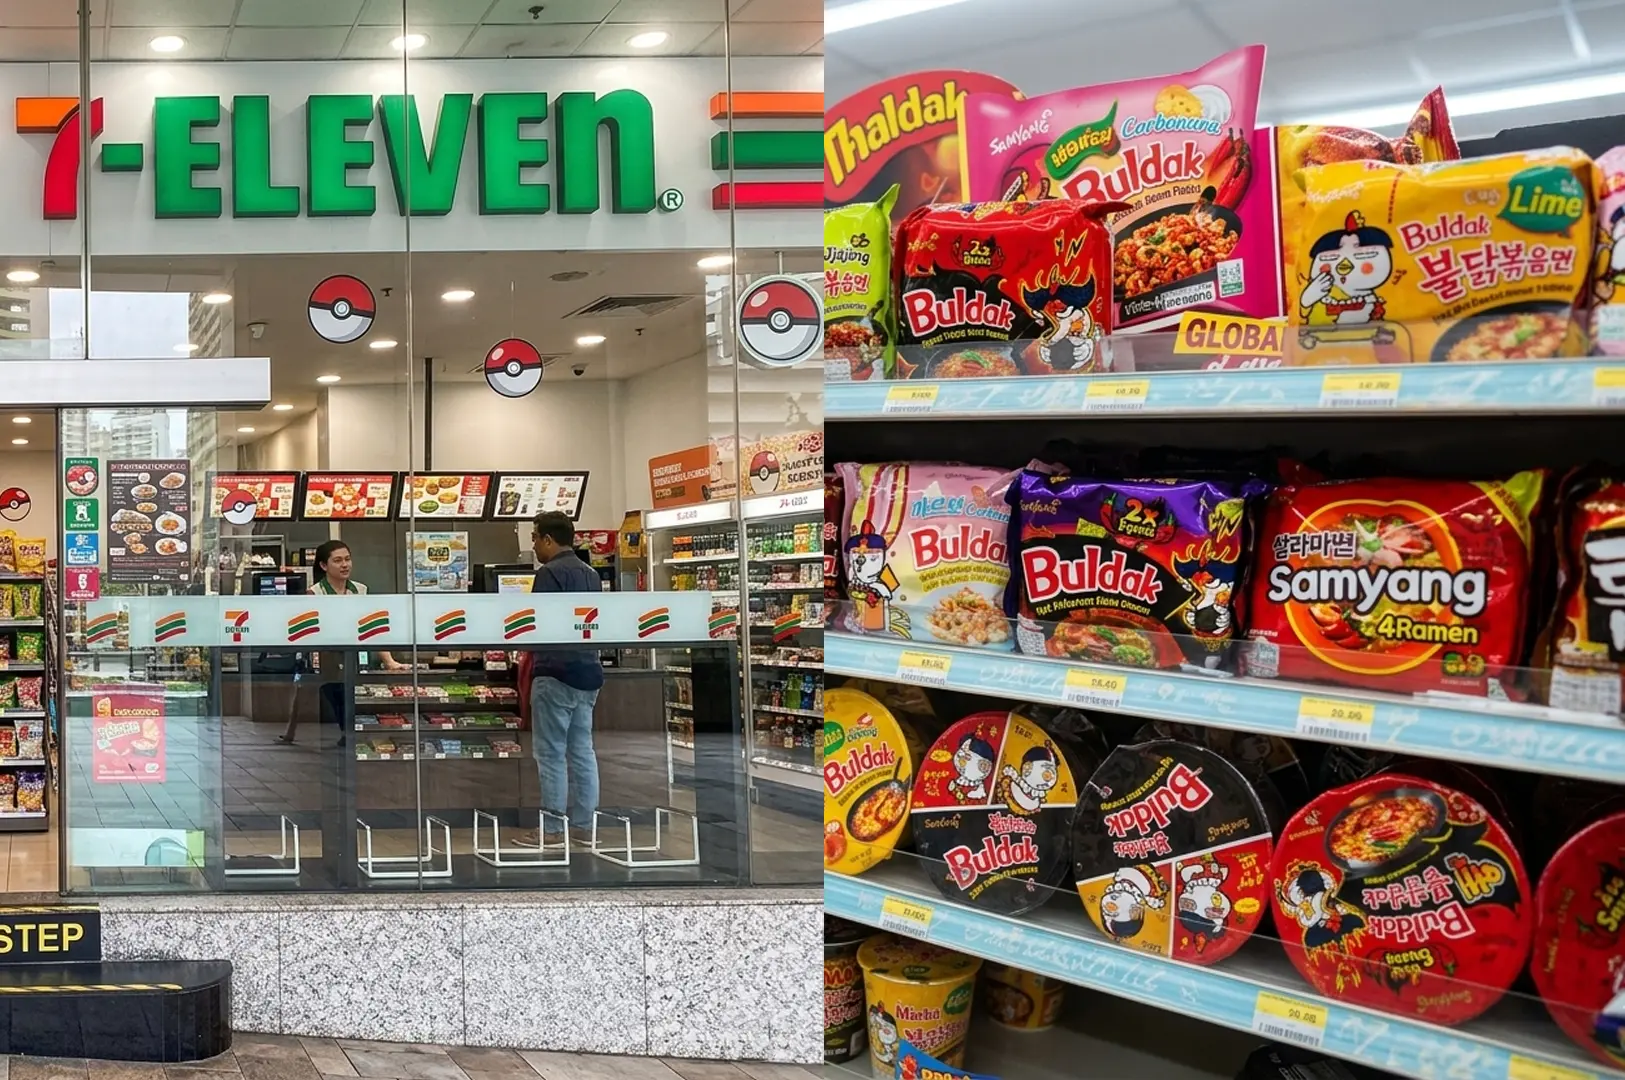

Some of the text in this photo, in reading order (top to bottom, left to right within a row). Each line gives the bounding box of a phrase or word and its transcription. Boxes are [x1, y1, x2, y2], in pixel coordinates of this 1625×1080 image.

[1510, 185, 1582, 217] Lime
[1399, 214, 1490, 252] Buldak
[903, 287, 1015, 336] Buldak
[1185, 317, 1284, 352] GLOBA
[1126, 499, 1159, 527] 2x
[909, 525, 1009, 570] Bulda
[1021, 545, 1163, 603] Buldak
[1267, 564, 1488, 617] Samyang
[1105, 763, 1213, 838] Buldak
[0, 923, 85, 954] STEP
